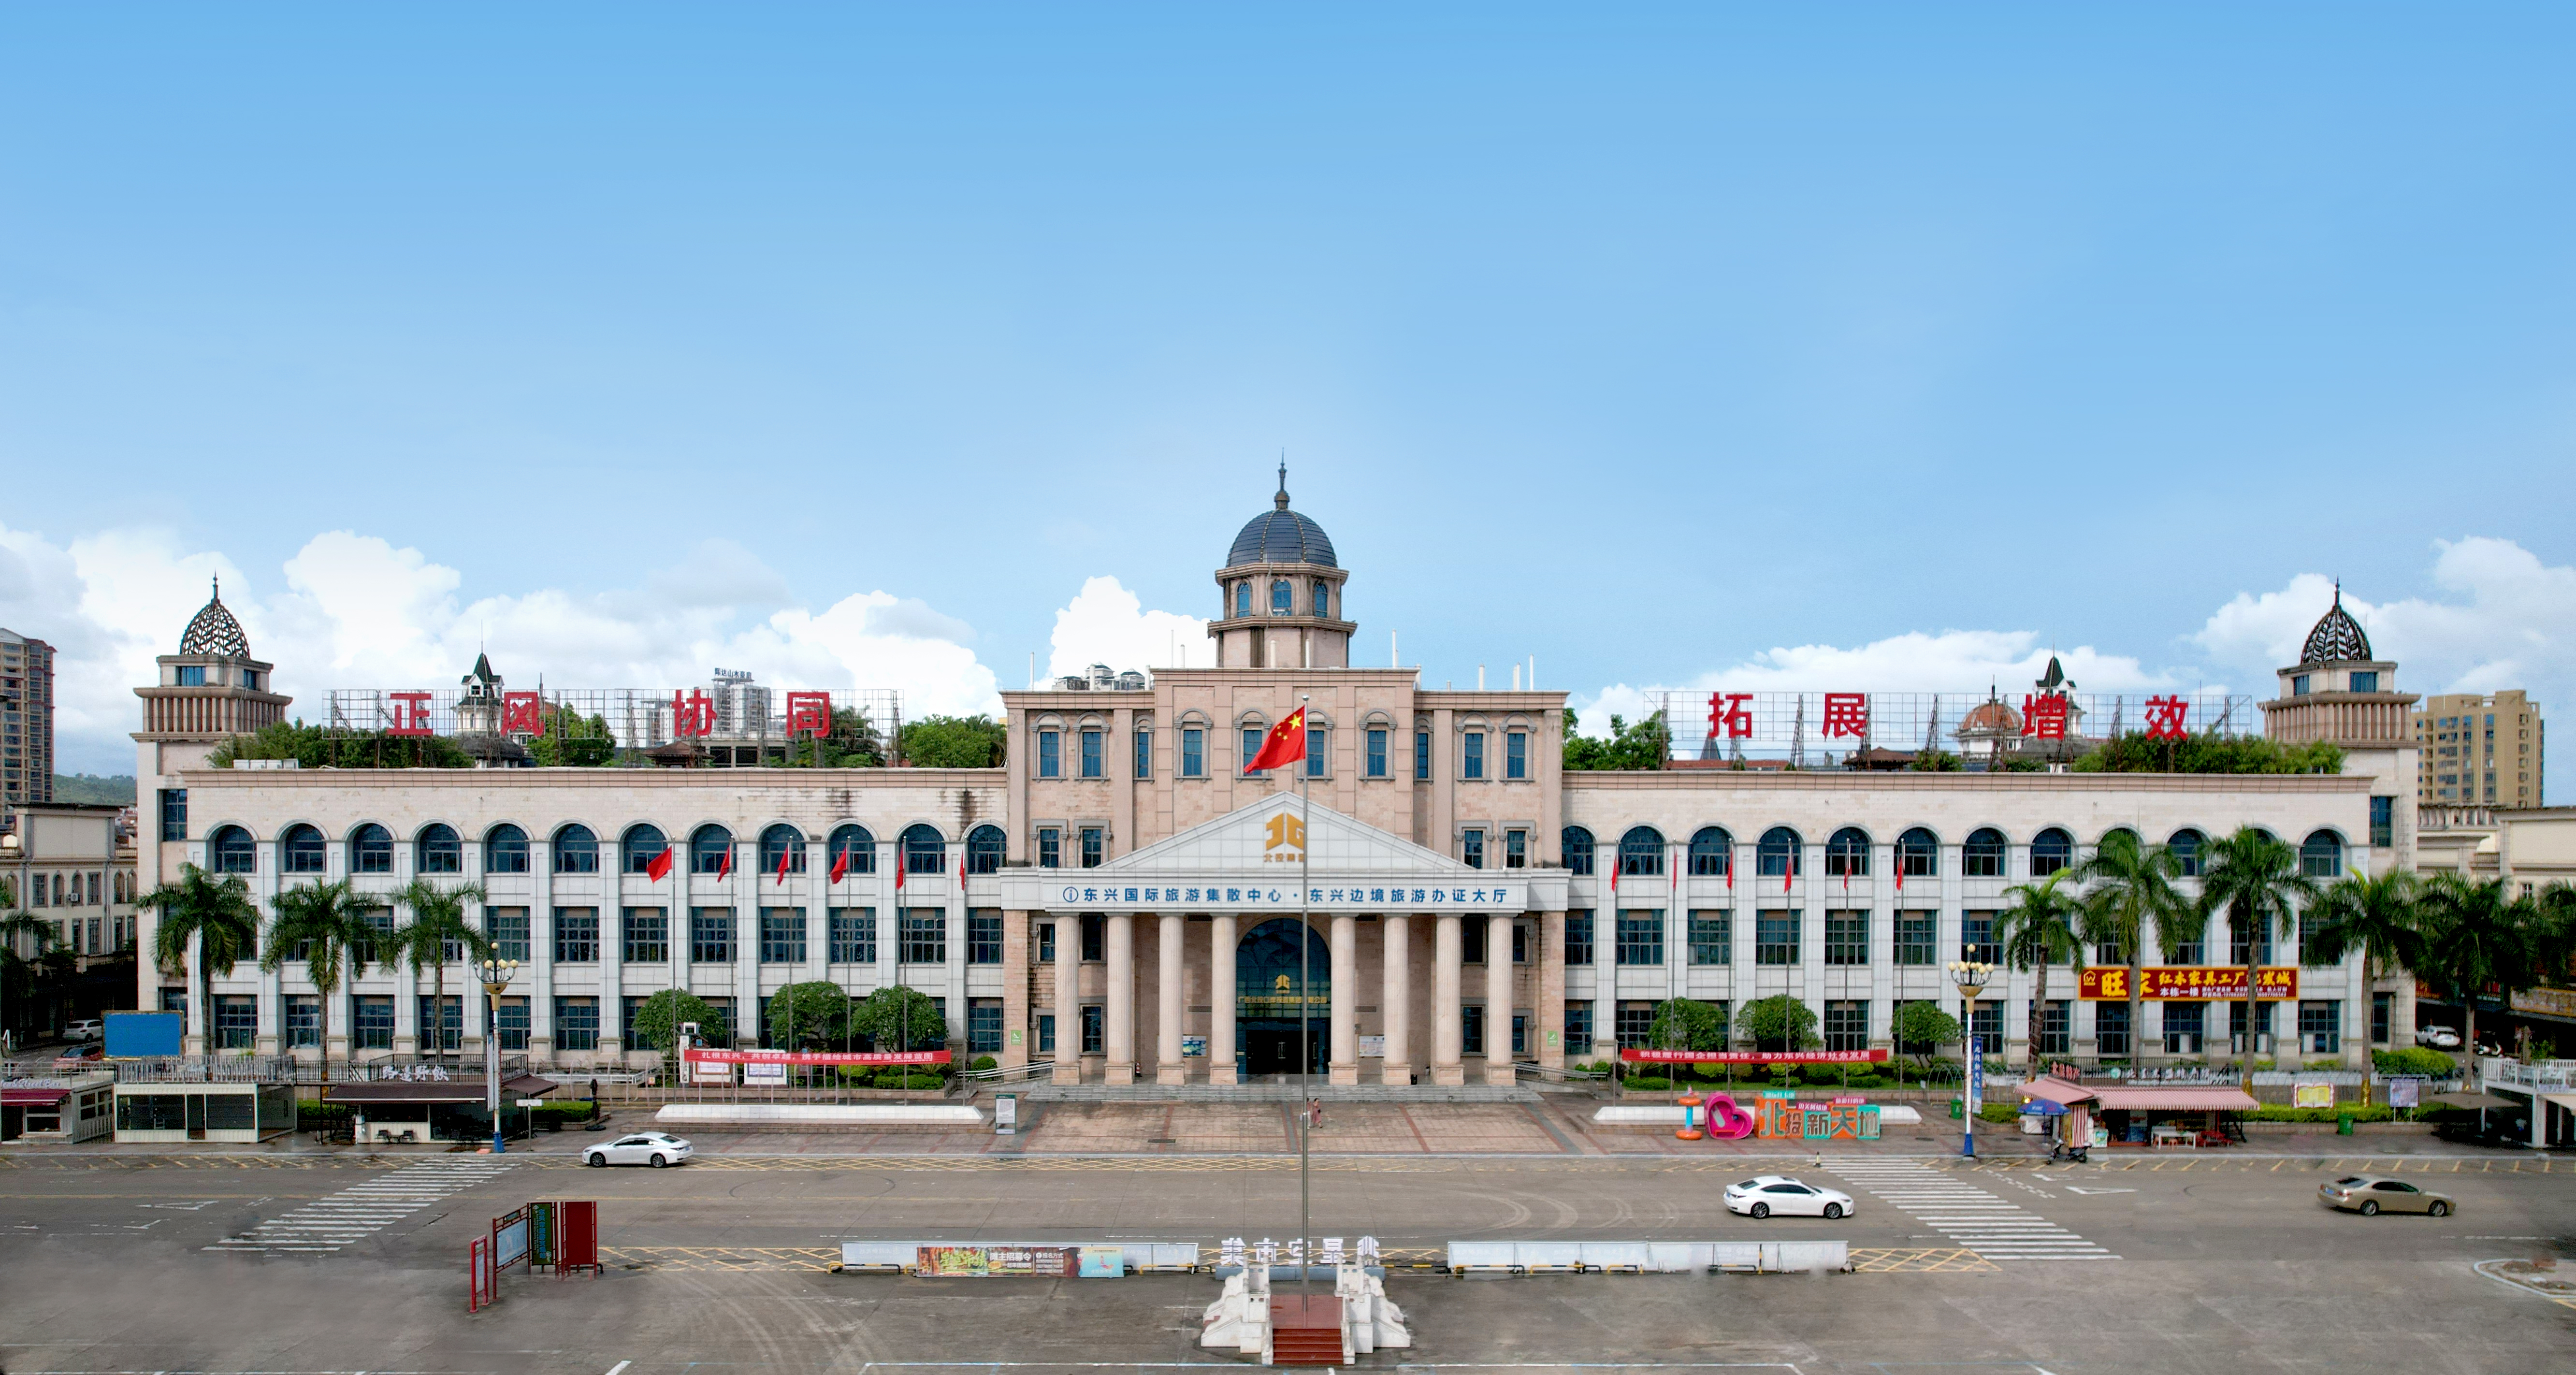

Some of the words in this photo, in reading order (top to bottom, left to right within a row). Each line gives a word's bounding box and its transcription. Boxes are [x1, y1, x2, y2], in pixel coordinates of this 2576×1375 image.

[2160, 986, 2199, 997] 本栋一楼
[1760, 1100, 1879, 1137] 北投新天地
